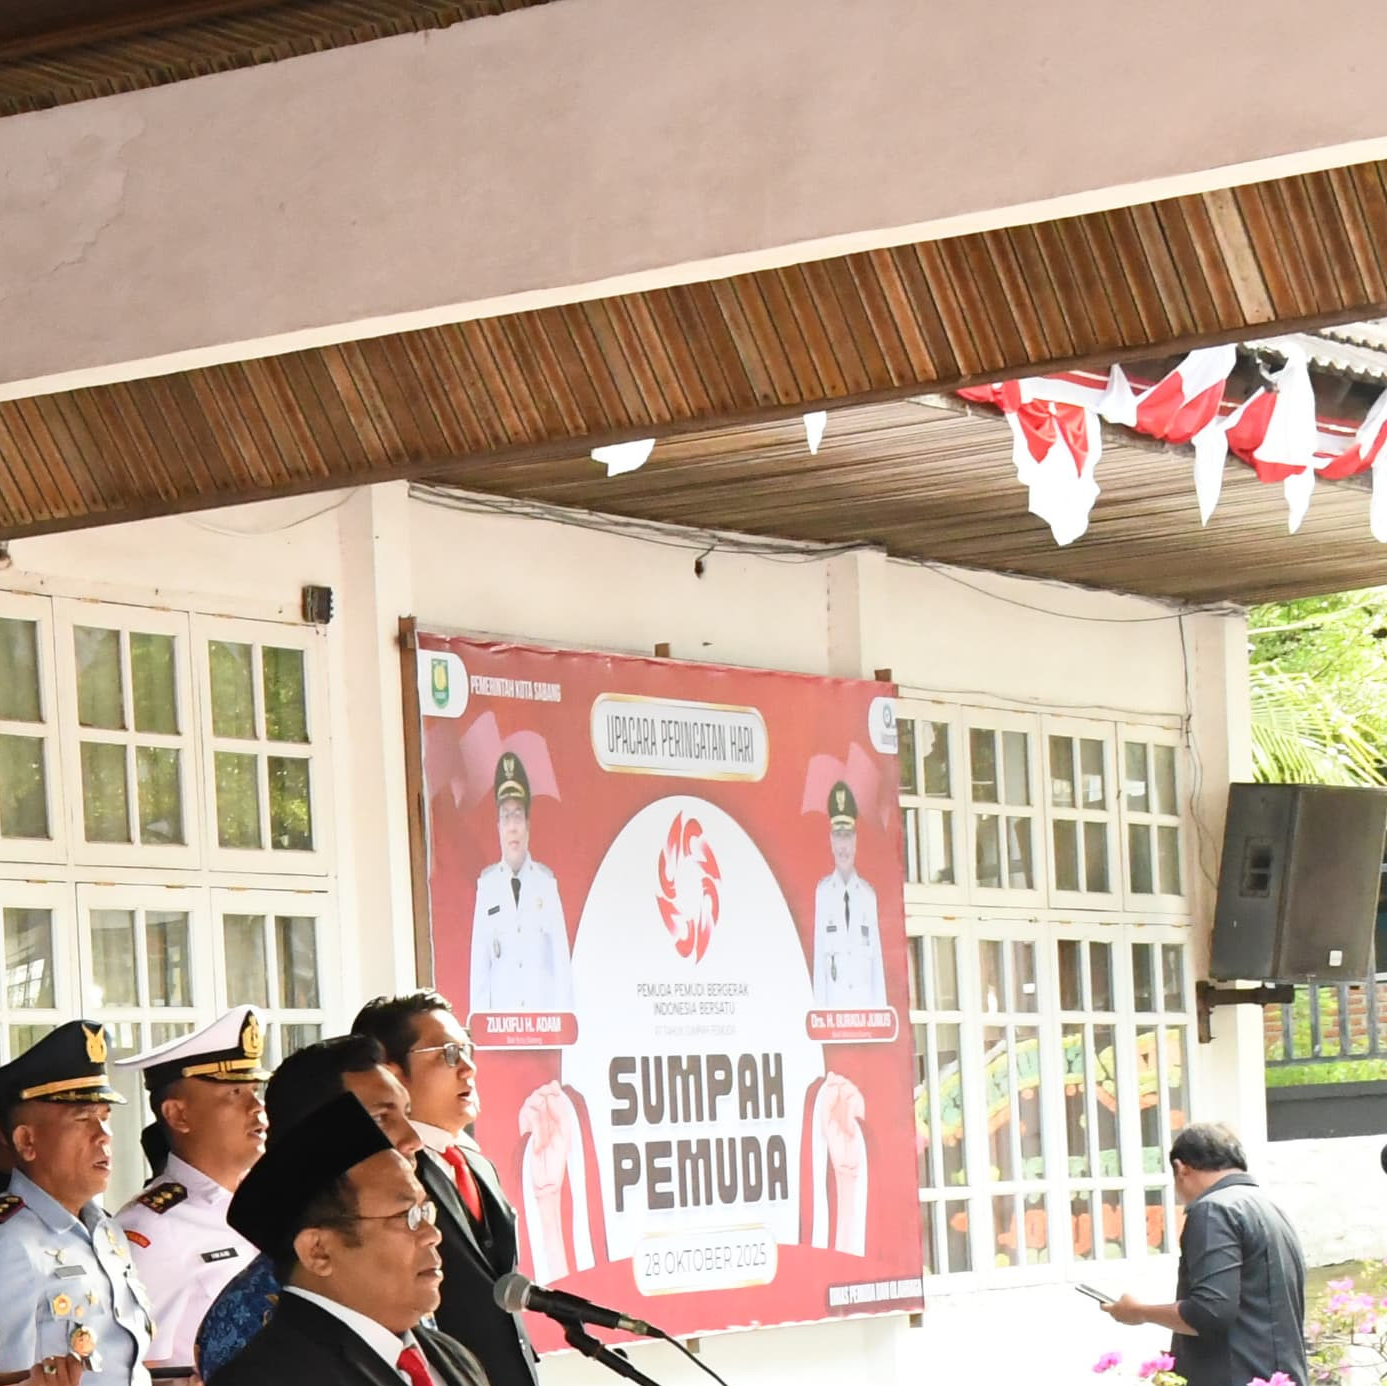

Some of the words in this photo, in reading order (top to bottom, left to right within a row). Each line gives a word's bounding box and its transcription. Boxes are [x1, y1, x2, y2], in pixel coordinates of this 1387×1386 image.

[470, 675, 515, 698] PEMERINTAH
[515, 680, 533, 700] KOTA
[606, 714, 658, 756] UPACARA
[660, 720, 727, 761] PERINGATAN
[729, 725, 755, 763] HARI
[636, 983, 672, 998] PEMUDA
[674, 983, 705, 997] PEMUDI
[707, 982, 749, 997] BERGERAK
[653, 1001, 697, 1016] INDONESIA
[699, 1001, 735, 1016] BERSATU
[536, 1016, 562, 1033] ADAM
[608, 1052, 785, 1127] SUMPAH
[612, 1134, 789, 1213] PEMUDA
[644, 1252, 661, 1277] 28
[664, 1246, 733, 1275] OKTOBER
[736, 1241, 768, 1268] 2025
